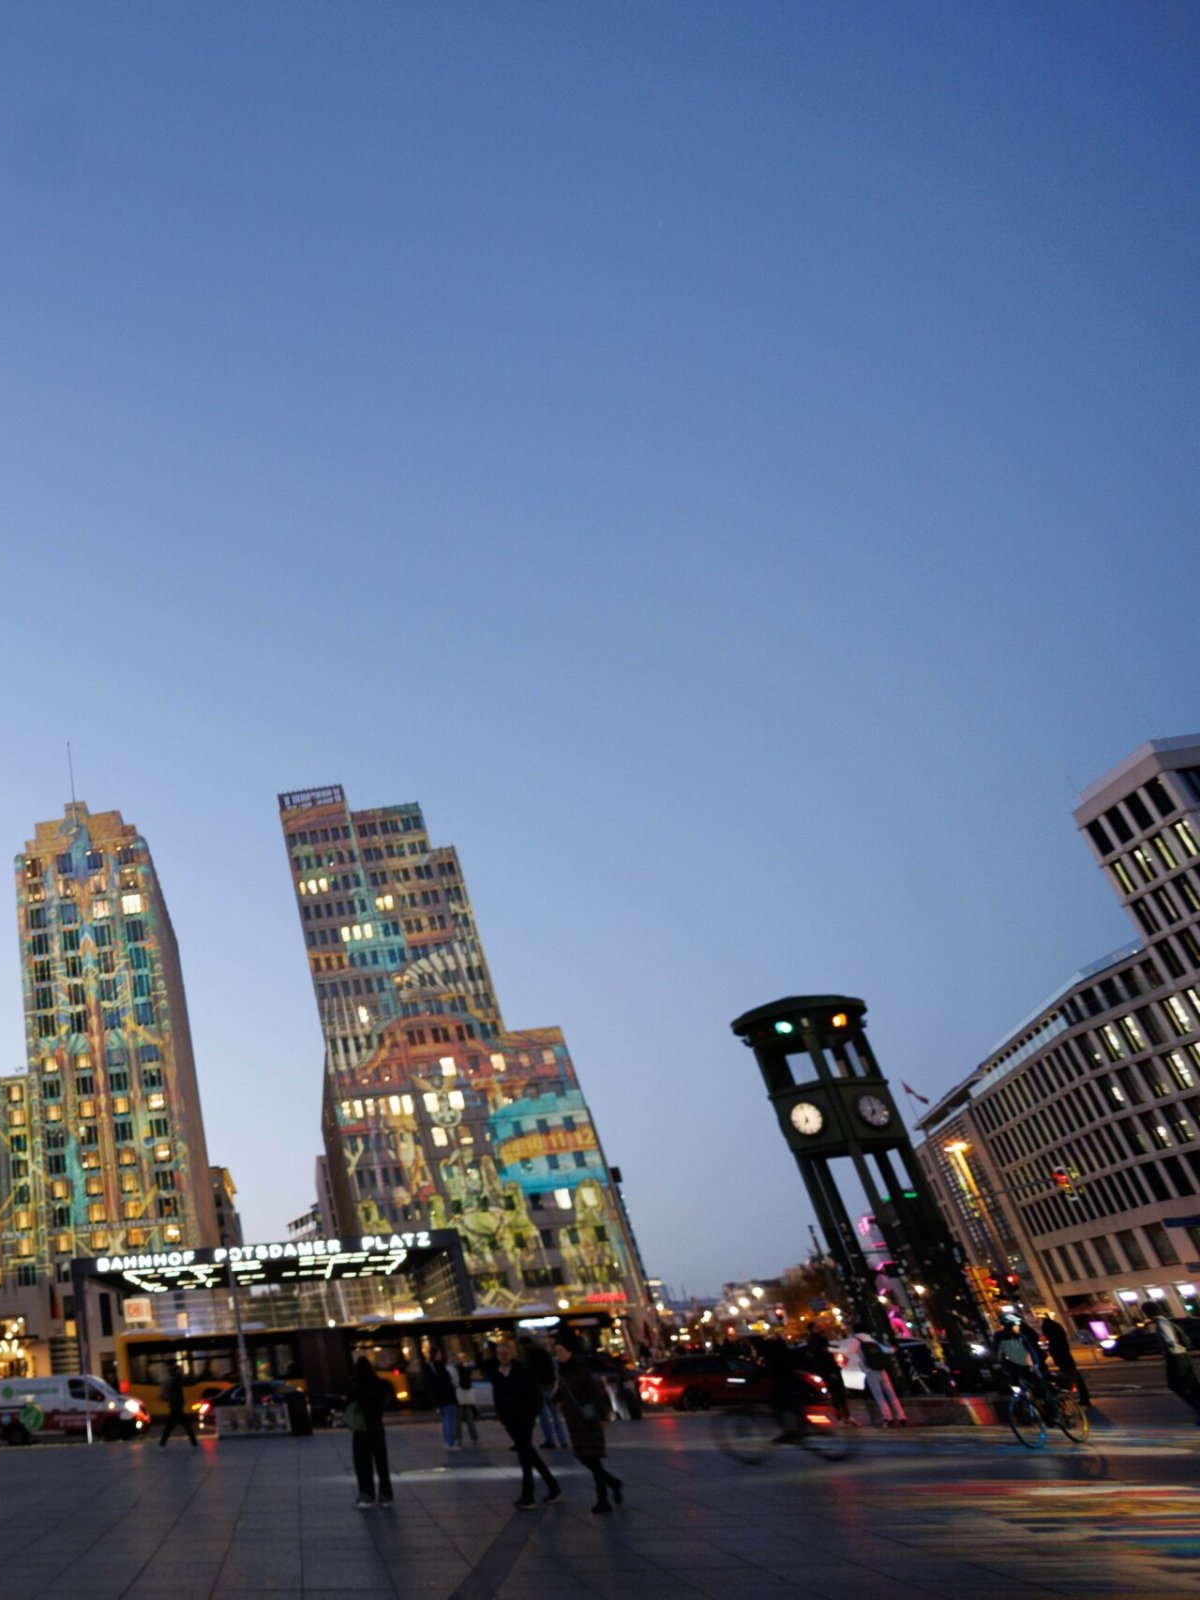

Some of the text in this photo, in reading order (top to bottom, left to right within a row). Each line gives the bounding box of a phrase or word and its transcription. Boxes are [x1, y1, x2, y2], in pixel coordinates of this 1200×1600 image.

[97, 1231, 431, 1272] BAHNHOF POTSDAMER PLATZ
